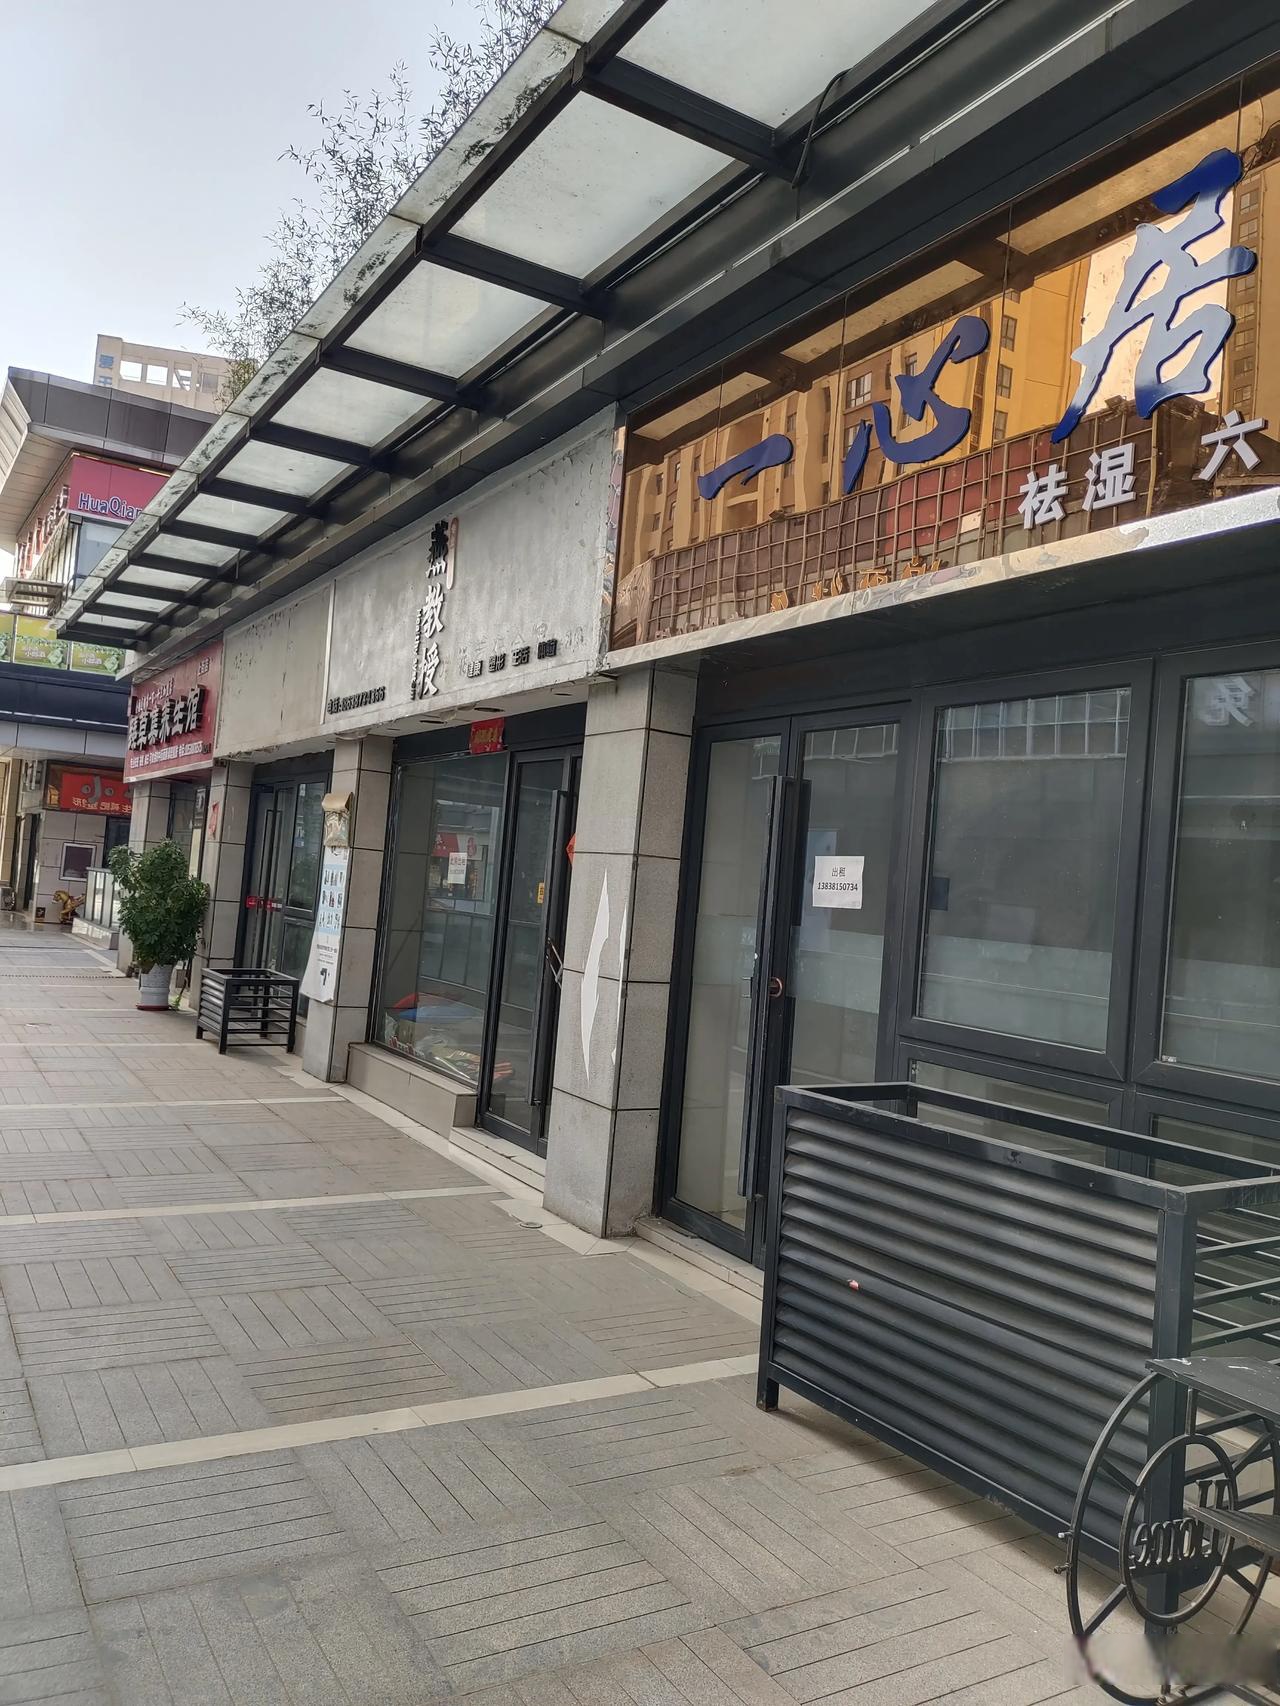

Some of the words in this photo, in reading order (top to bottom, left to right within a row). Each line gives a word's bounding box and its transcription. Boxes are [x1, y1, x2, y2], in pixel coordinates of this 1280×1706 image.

[697, 147, 1258, 500] 一心居
[1018, 442, 1136, 529] 祛湿
[1199, 409, 1266, 481] 六
[817, 882, 858, 891] 13838150734
[832, 866, 846, 877] 出租
